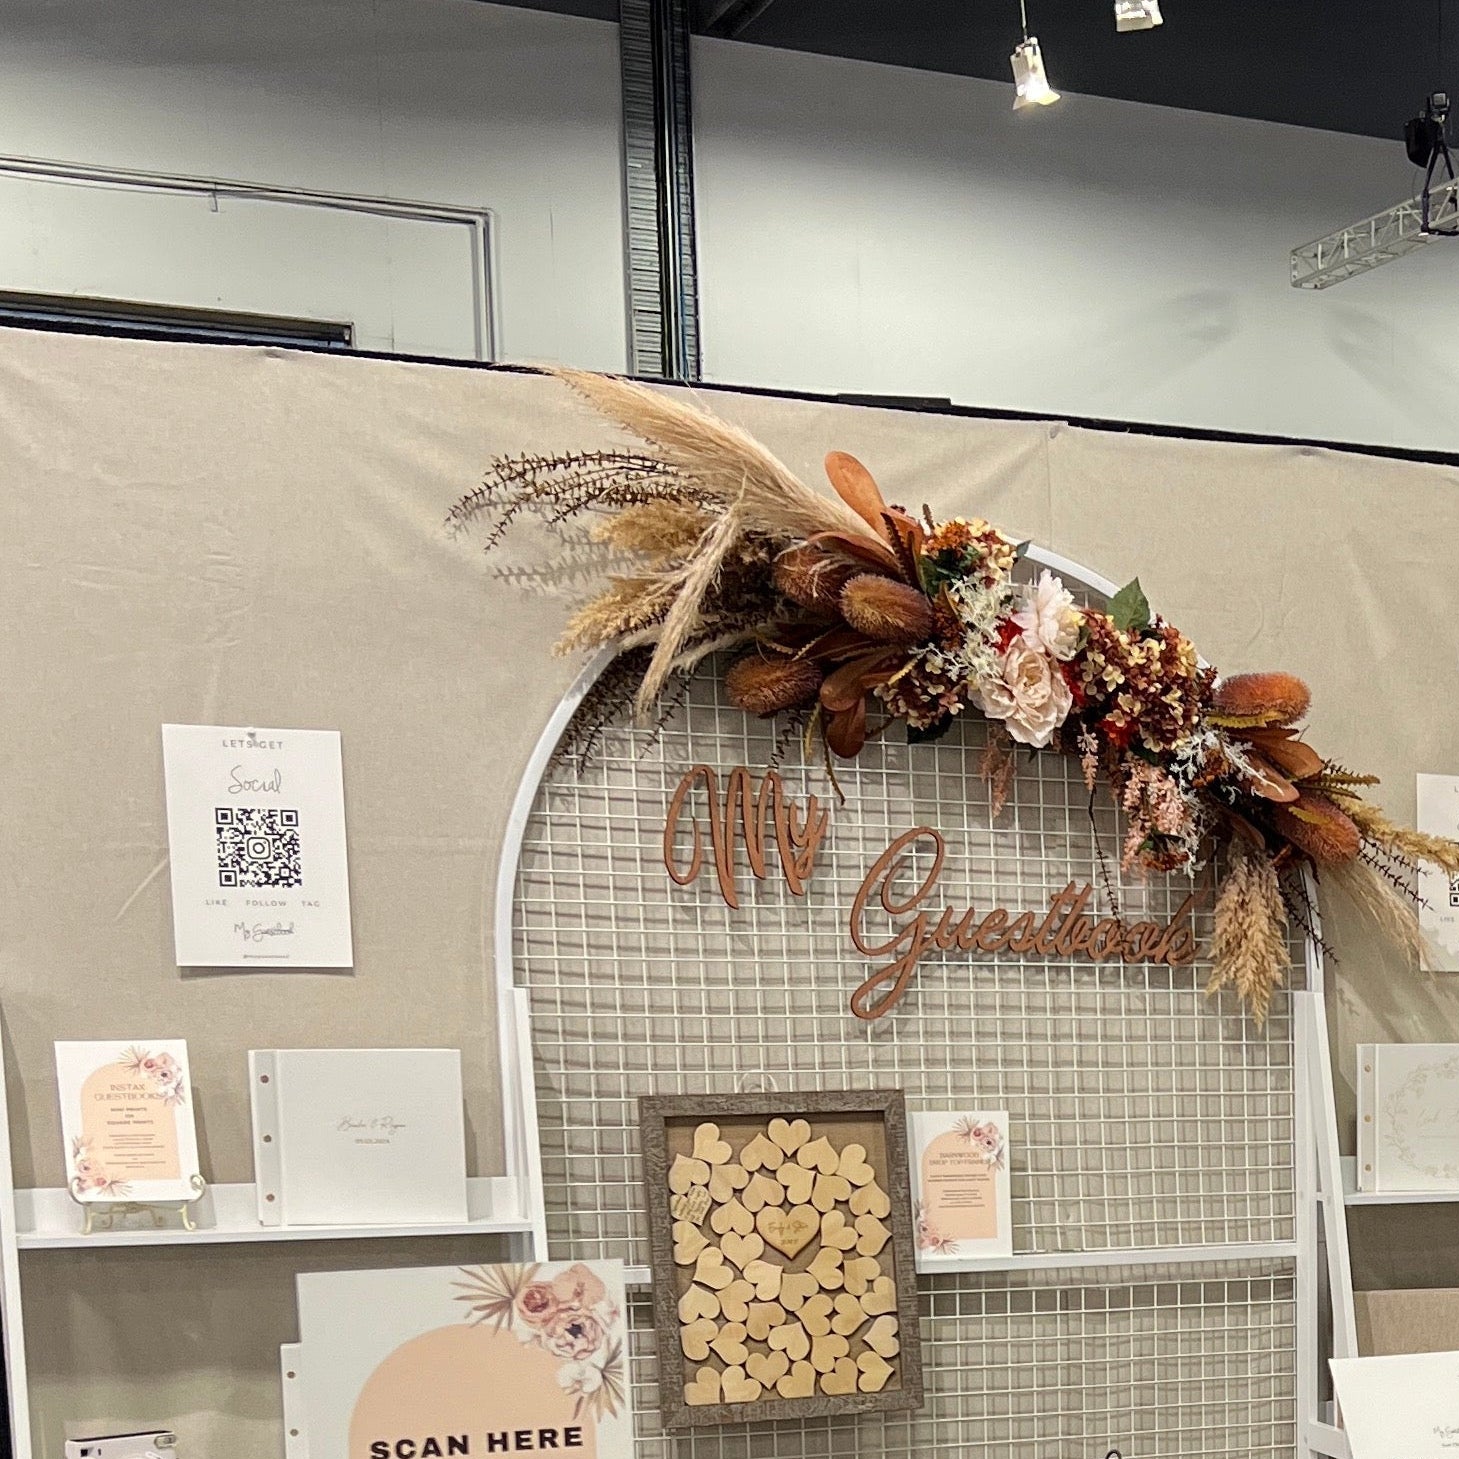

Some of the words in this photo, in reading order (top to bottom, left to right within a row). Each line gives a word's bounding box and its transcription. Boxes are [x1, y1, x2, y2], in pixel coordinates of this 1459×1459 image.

[222, 739, 253, 749] LETS
[257, 740, 284, 749] GET
[228, 765, 282, 795] Social
[663, 765, 829, 910] My
[849, 825, 1204, 1020] Guestbook
[110, 1083, 145, 1091] INSTAX
[487, 1426, 583, 1453] HERE
